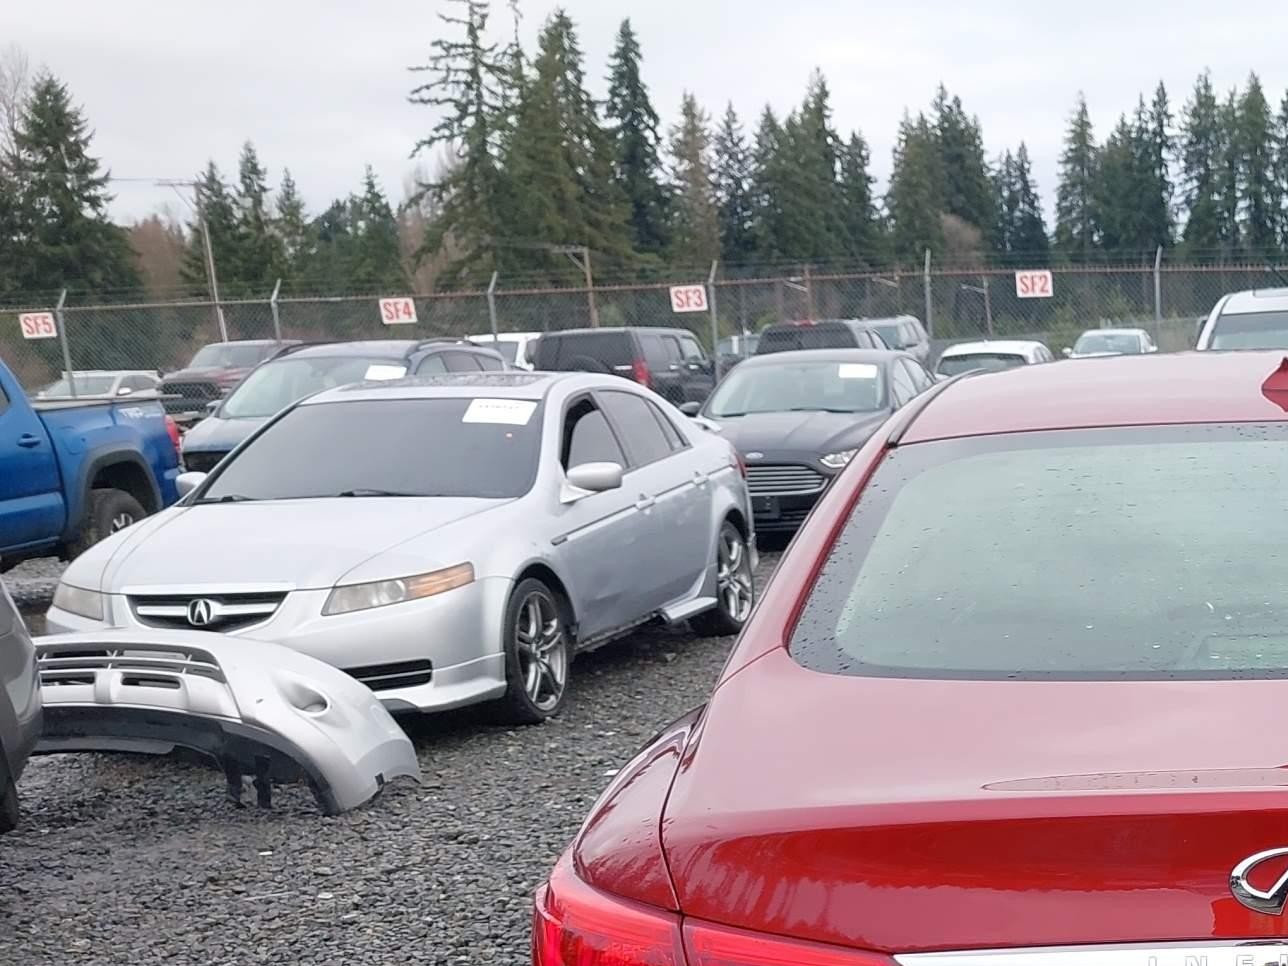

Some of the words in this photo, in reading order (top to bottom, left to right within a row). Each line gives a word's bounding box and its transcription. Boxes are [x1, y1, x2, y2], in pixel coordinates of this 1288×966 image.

[1020, 274, 1049, 293] SF2
[675, 289, 704, 308] SF3
[383, 301, 413, 320] SF4
[23, 315, 53, 335] SF5
